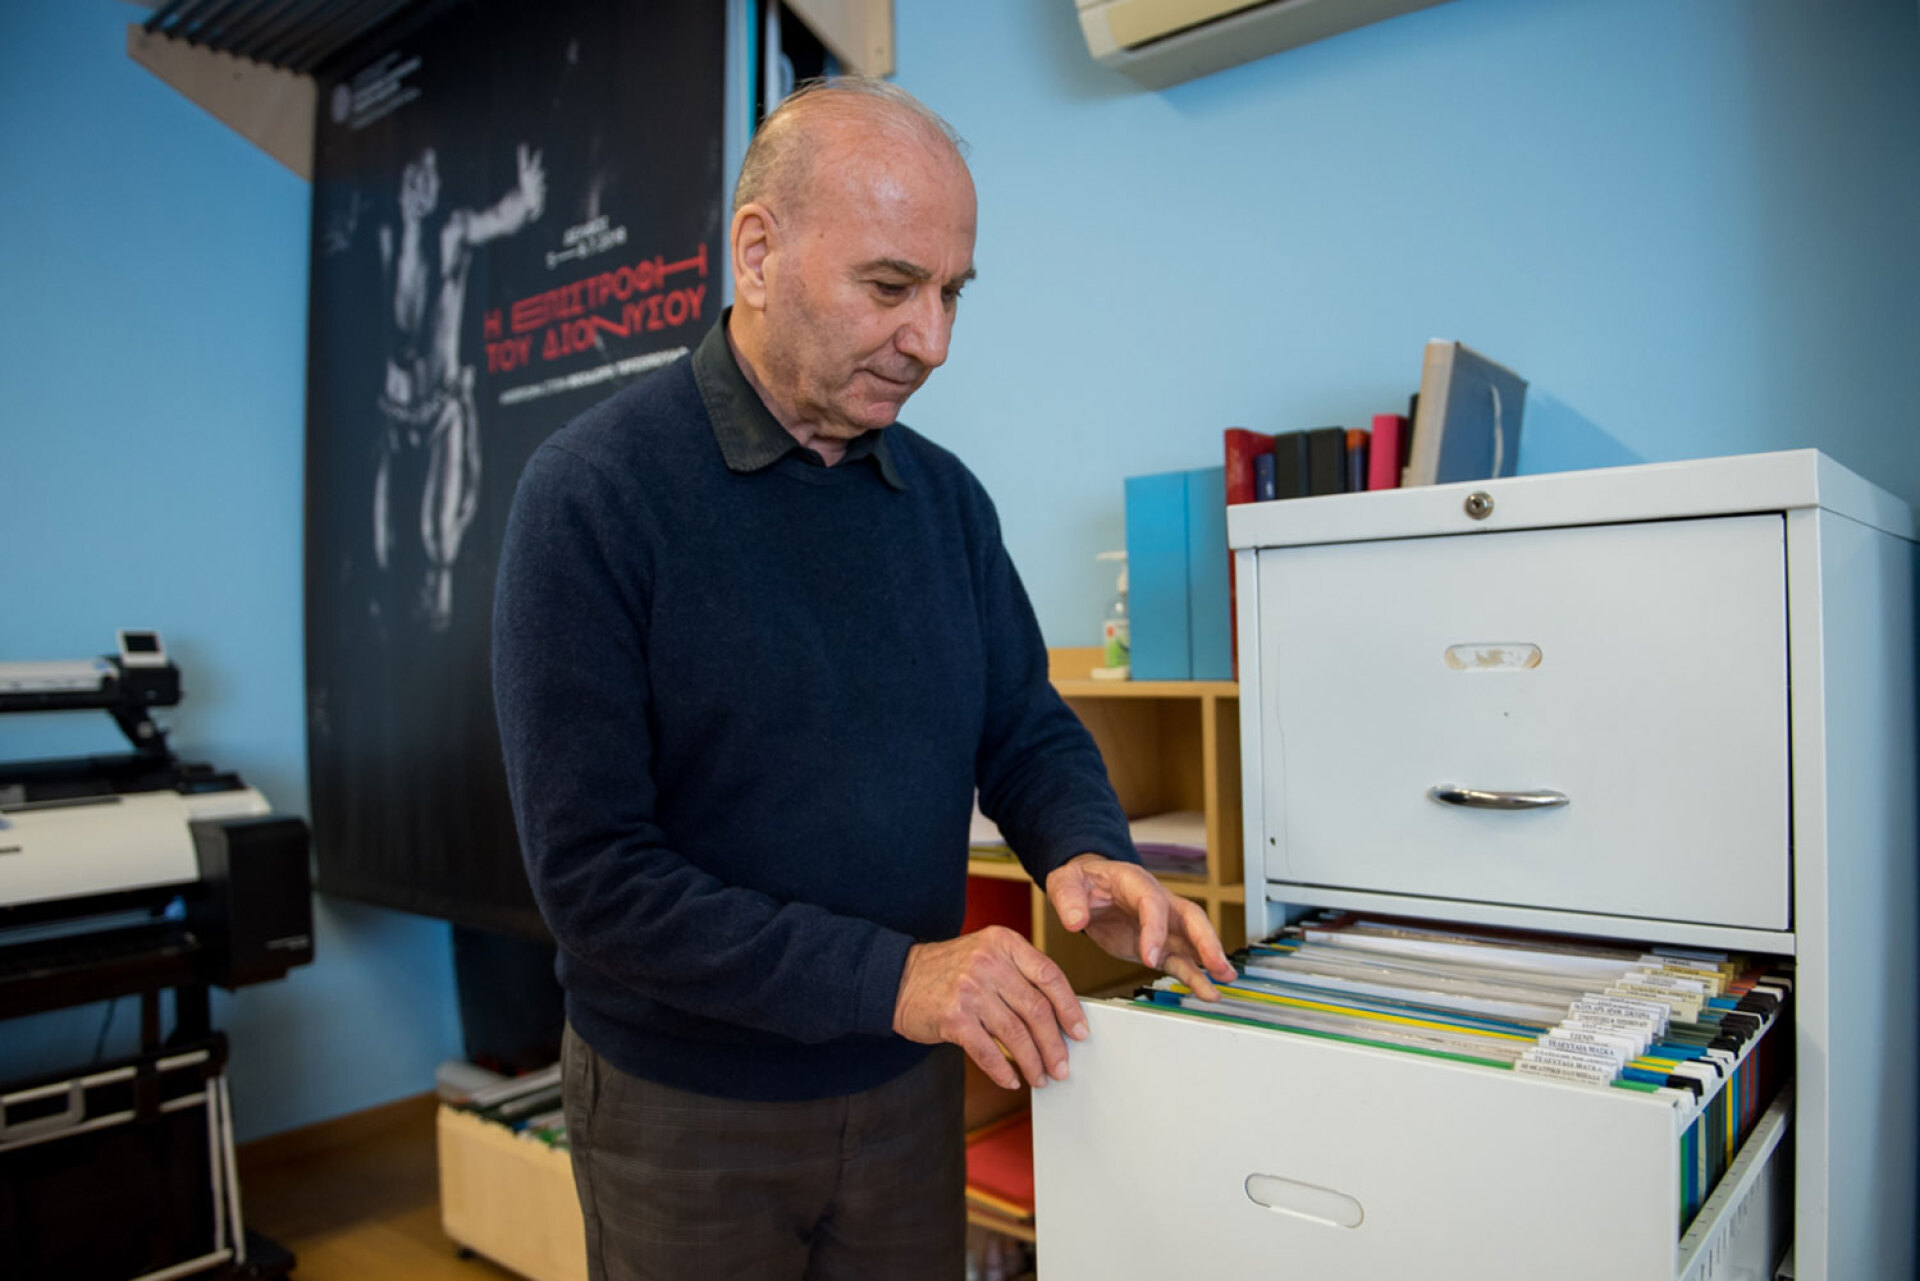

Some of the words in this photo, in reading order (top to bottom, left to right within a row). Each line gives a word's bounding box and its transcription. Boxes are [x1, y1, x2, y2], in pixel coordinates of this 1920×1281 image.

[484, 308, 502, 339] Η
[511, 242, 708, 333] ΕΠΙΣΤΡΟΦΗ
[485, 335, 532, 373] ΤΟΥ
[542, 284, 706, 360] ΔΙΟΝΥΣΟΥ
